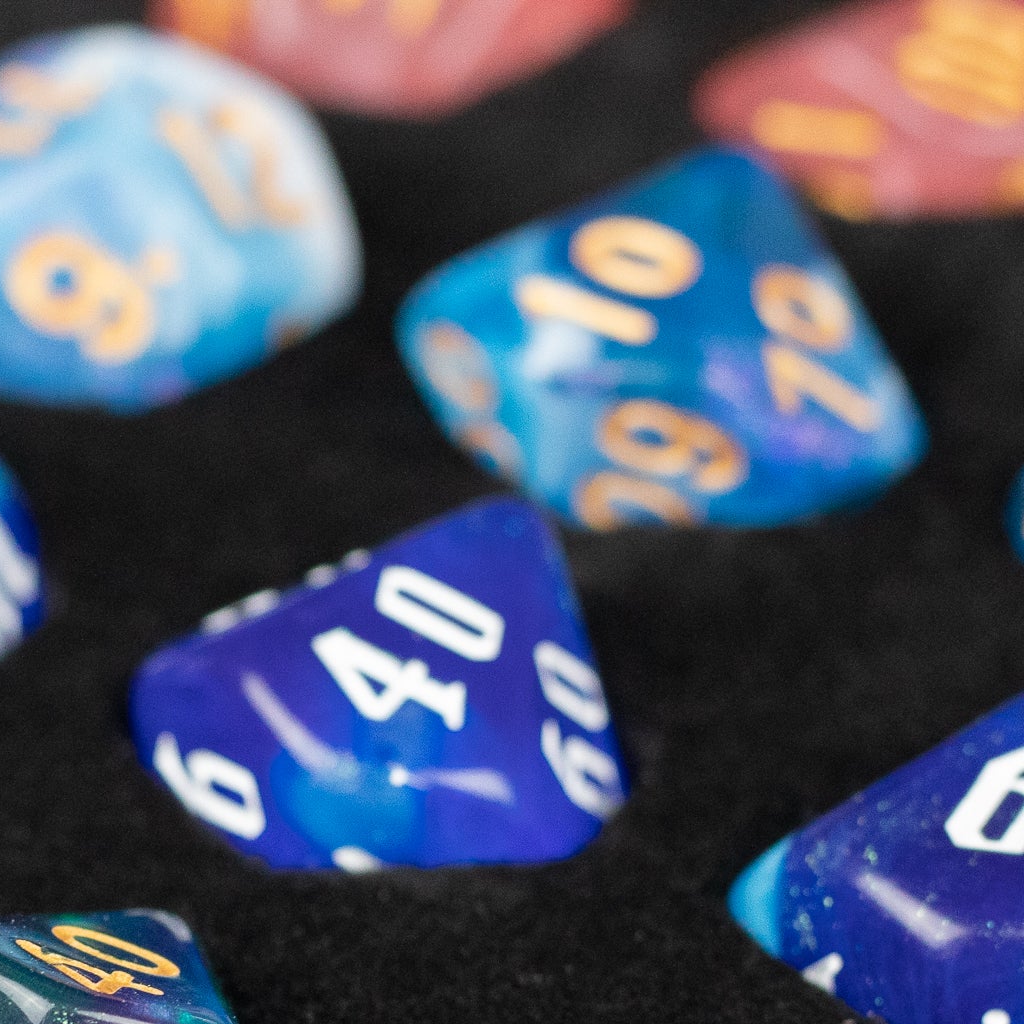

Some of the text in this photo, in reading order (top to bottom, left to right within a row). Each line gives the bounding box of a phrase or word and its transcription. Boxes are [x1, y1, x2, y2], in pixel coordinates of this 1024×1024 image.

[514, 214, 704, 347] 10
[312, 564, 505, 733] 40
[15, 923, 182, 999] 40
